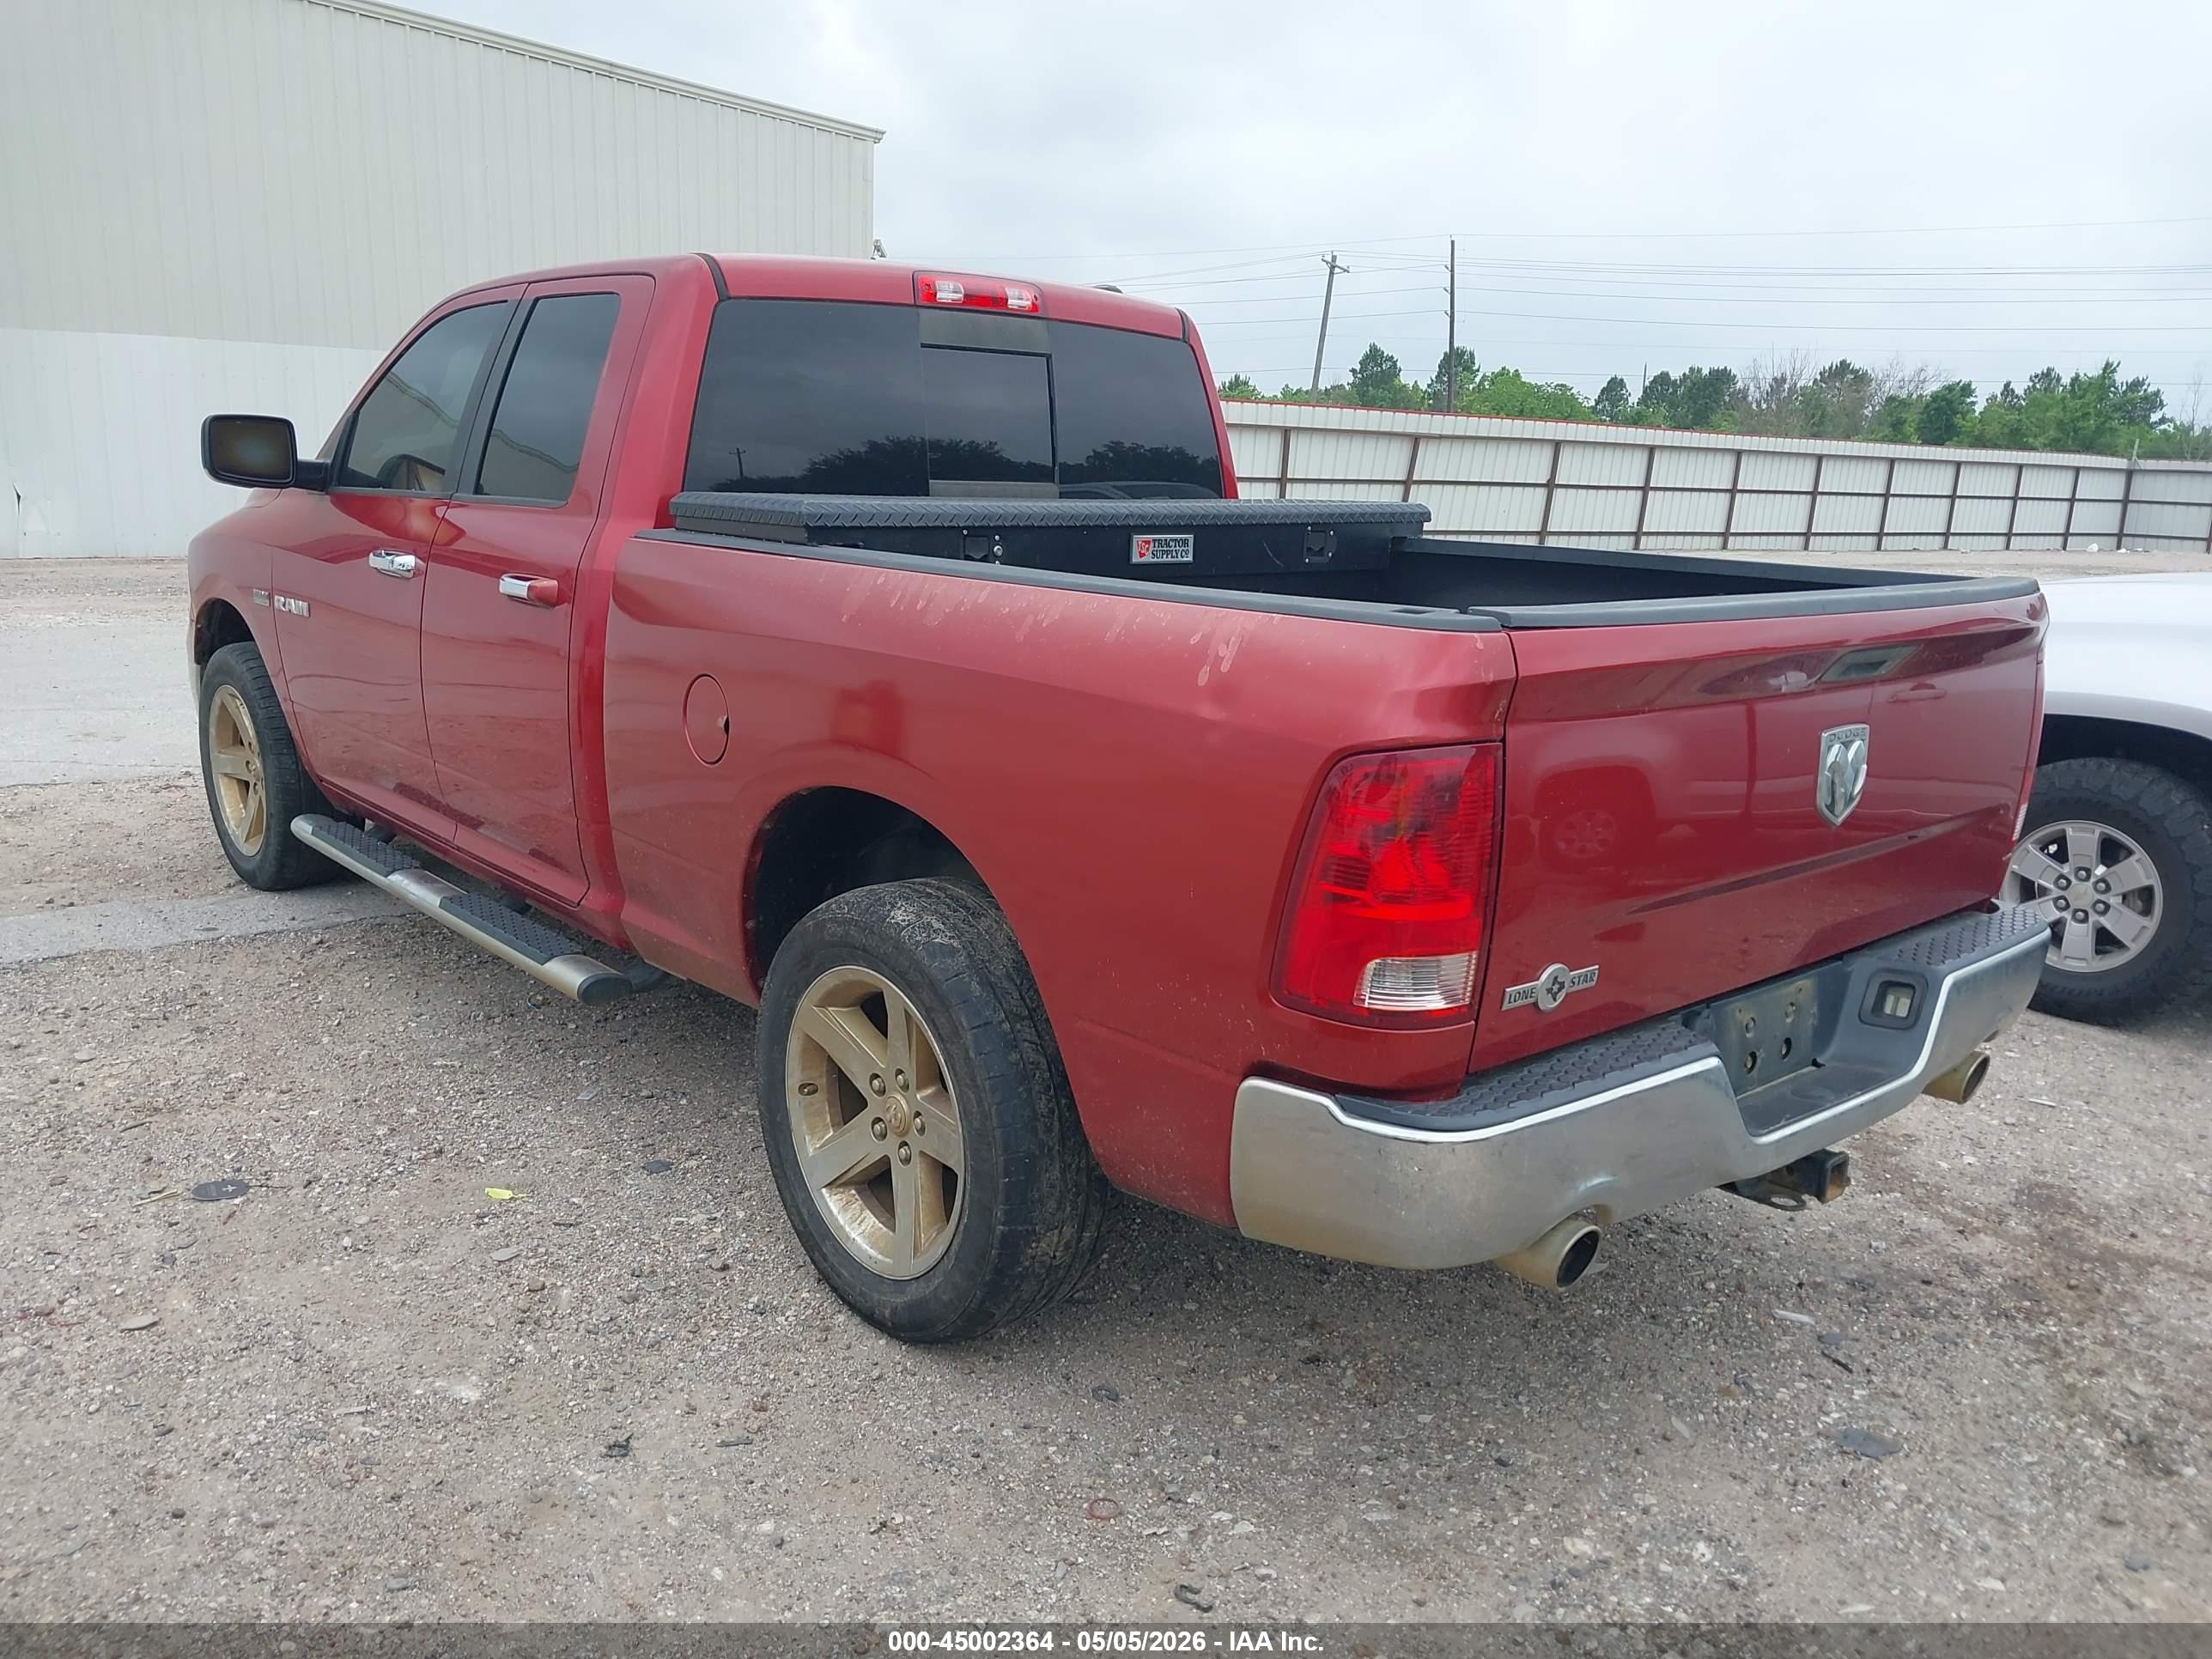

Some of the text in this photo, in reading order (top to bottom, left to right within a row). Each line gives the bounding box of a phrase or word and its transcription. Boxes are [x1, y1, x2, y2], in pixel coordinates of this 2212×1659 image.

[1152, 538, 1189, 548] TRACTOR
[1152, 549, 1180, 559] SUPPLY
[275, 594, 310, 617] RAM
[1829, 727, 1867, 743] DODGE
[1507, 971, 1596, 1005] LONE STAR
